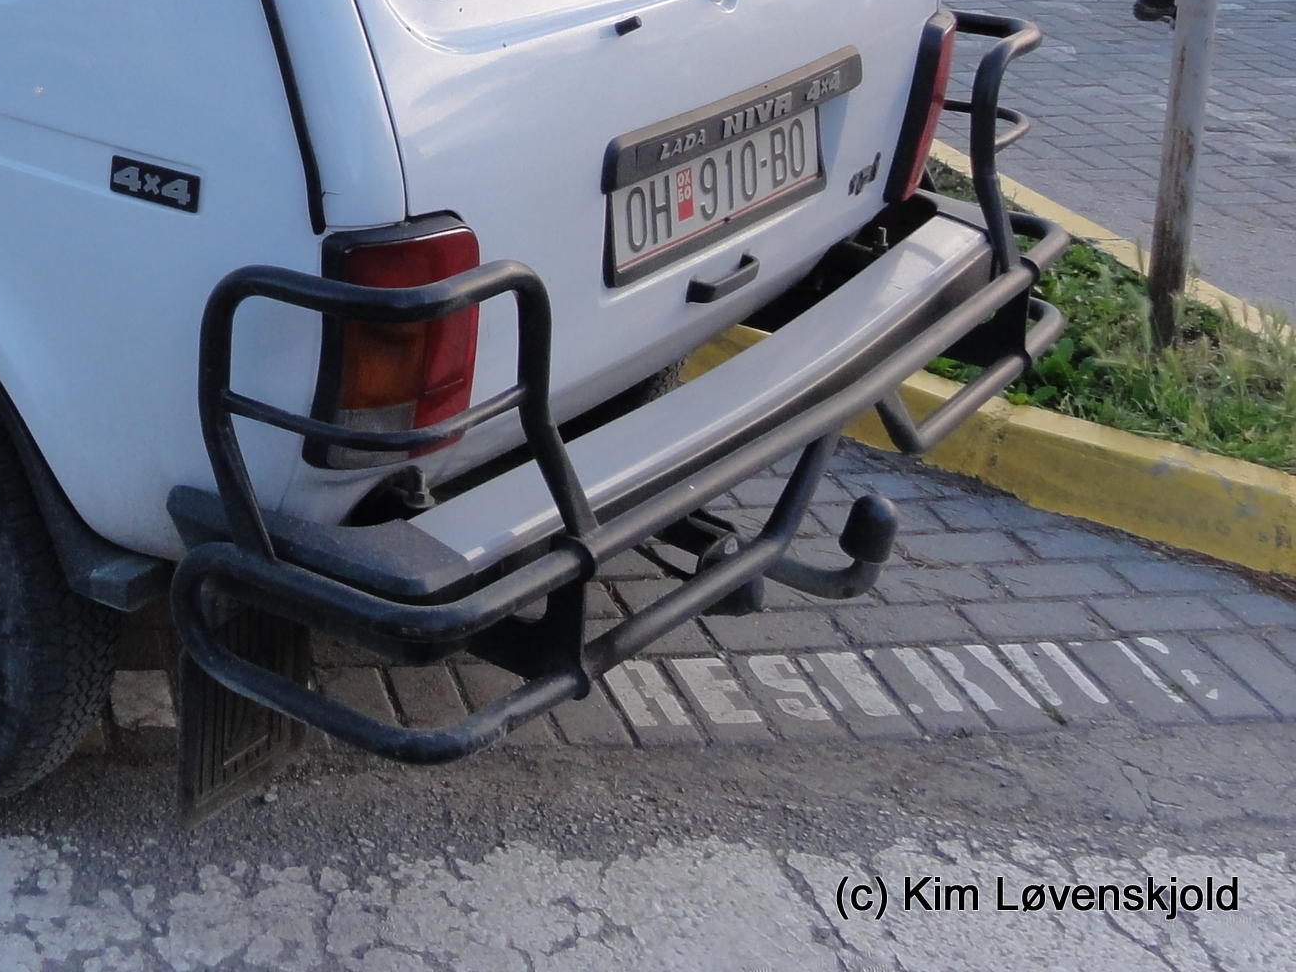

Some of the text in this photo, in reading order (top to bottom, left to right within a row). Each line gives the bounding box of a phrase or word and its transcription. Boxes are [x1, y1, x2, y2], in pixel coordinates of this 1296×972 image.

[659, 70, 841, 161] LADA NIVA 4x4
[113, 166, 191, 205] 4x4
[626, 174, 673, 254] OH
